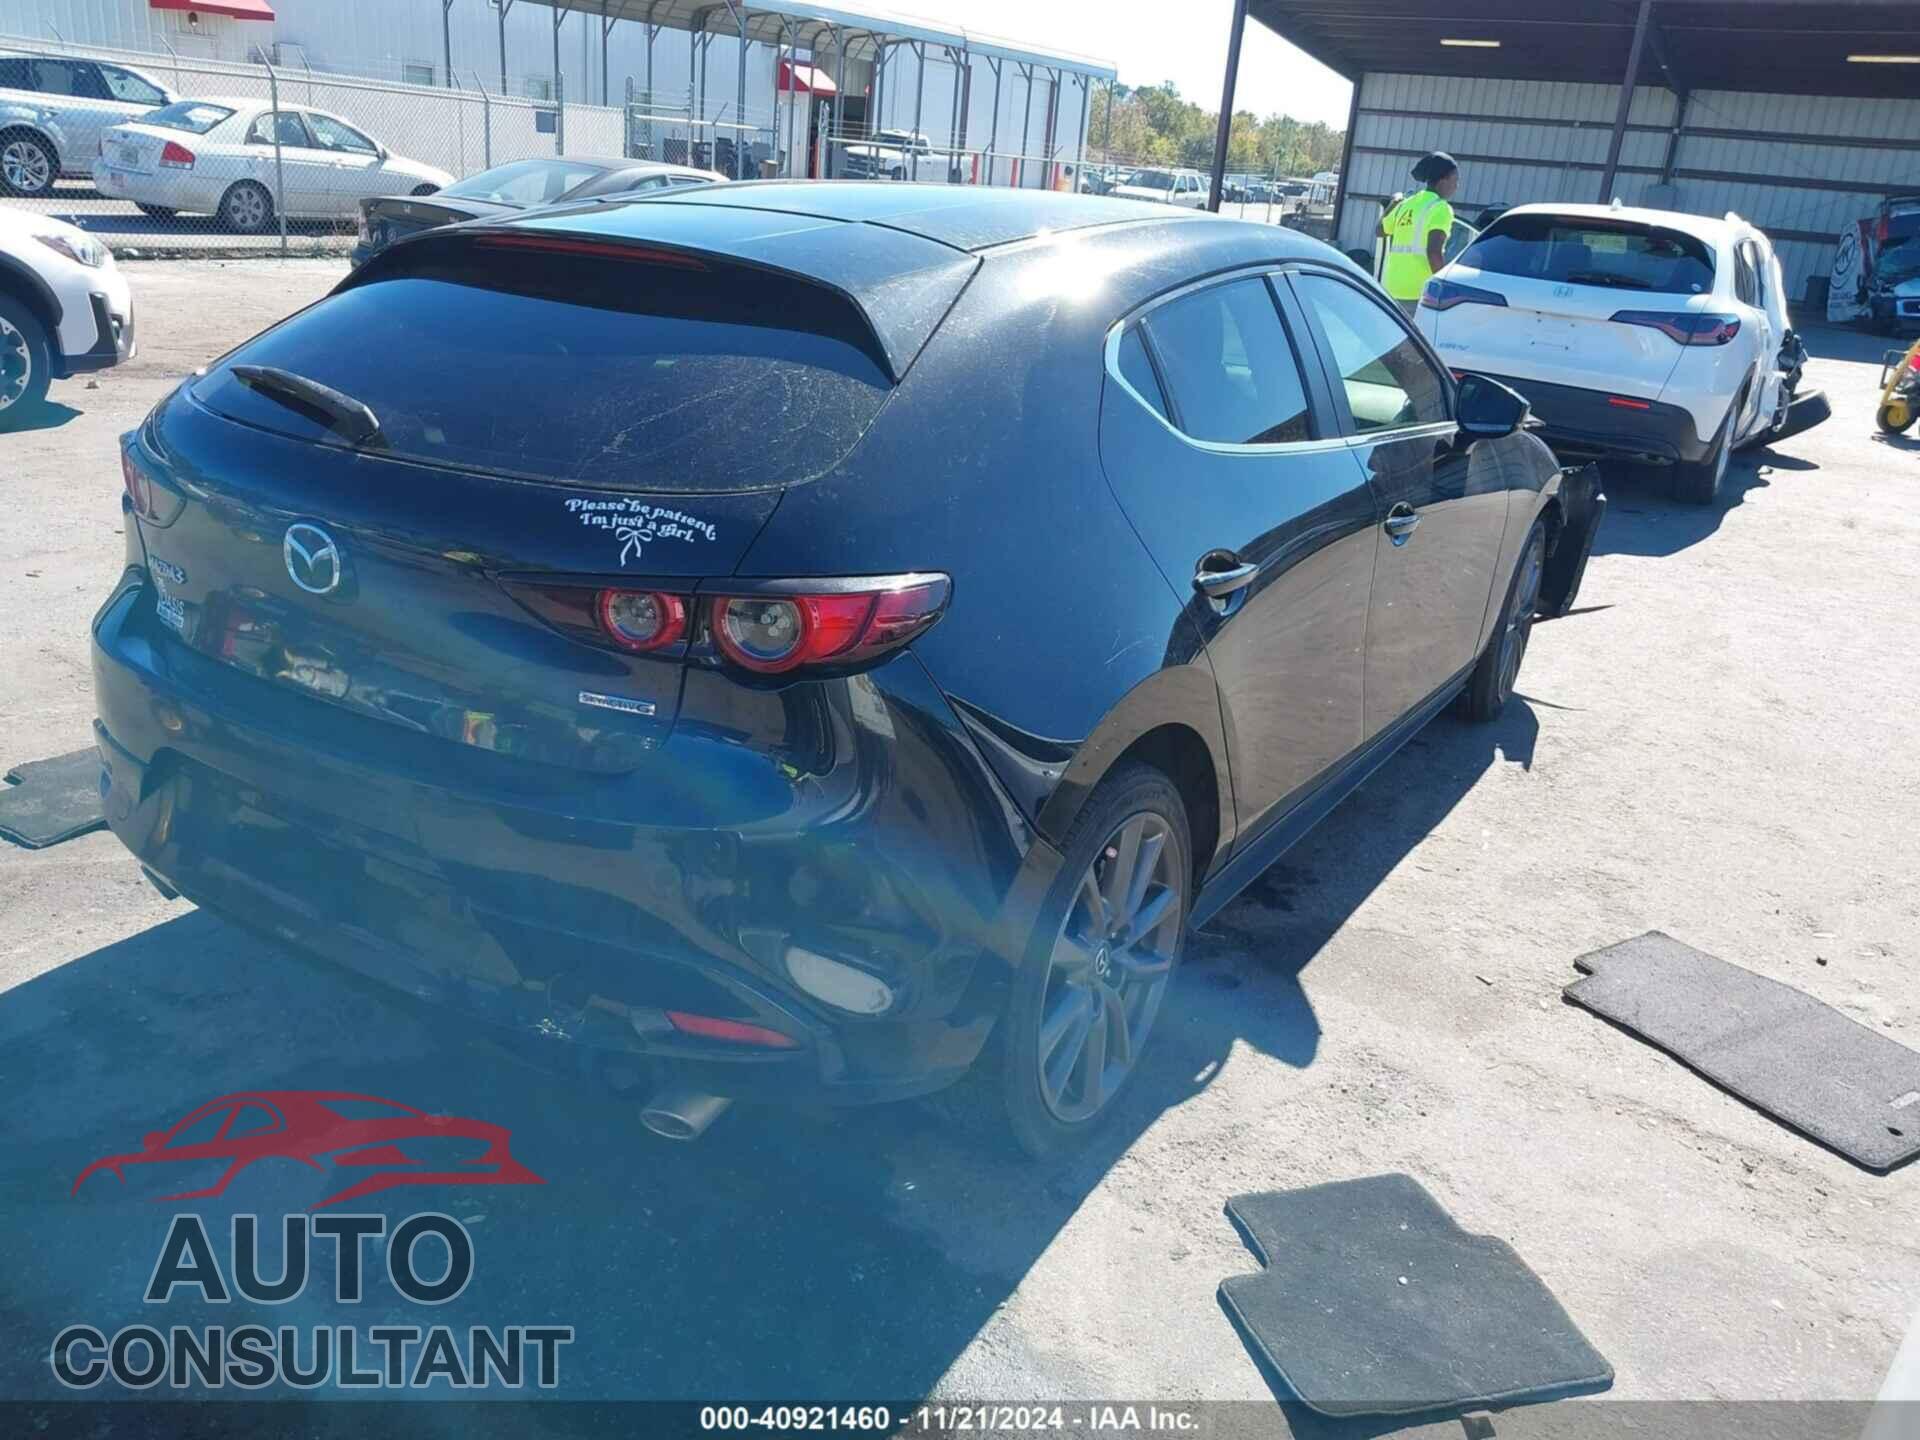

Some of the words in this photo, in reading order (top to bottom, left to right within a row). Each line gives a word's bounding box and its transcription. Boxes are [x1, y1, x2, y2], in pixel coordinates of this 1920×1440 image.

[564, 498, 626, 512] Please
[624, 497, 651, 514] be
[646, 507, 717, 541] patient
[601, 513, 643, 529] just
[647, 522, 657, 531] a
